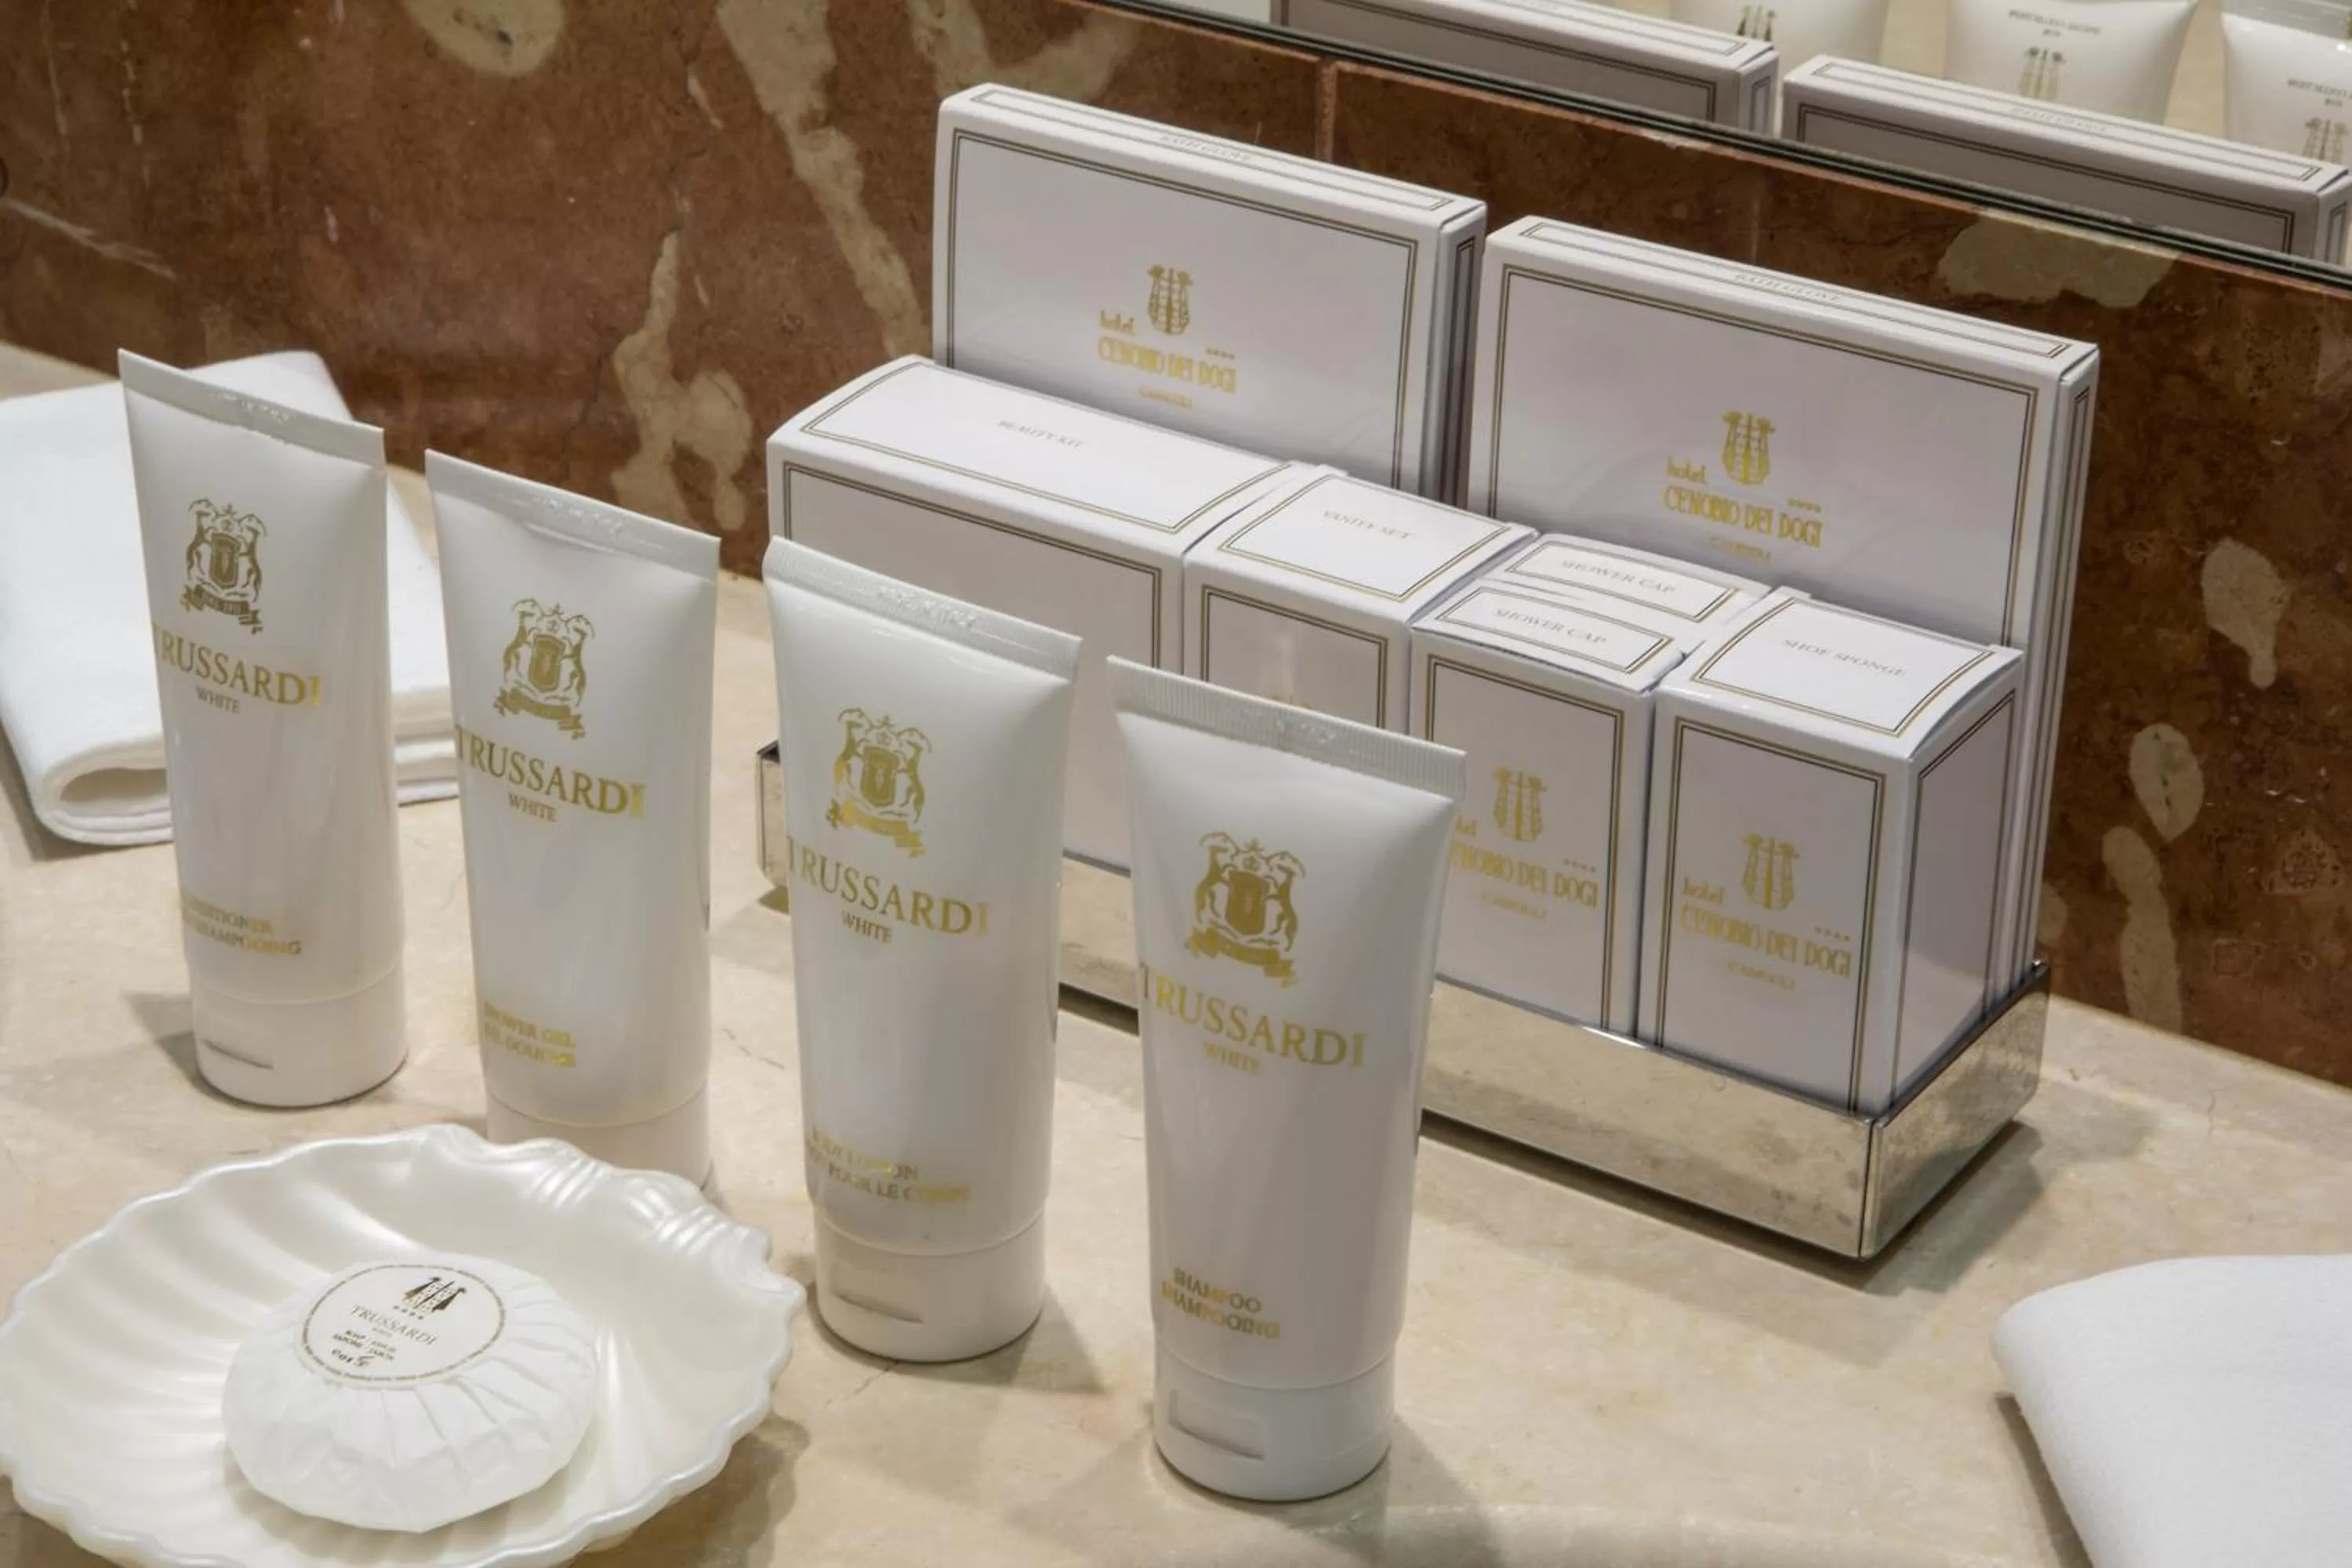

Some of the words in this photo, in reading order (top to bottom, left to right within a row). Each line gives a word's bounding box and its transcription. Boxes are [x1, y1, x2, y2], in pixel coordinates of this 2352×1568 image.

[1743, 503, 1773, 535] DEI
[1777, 511, 1824, 548] DOGI
[1560, 559, 1636, 584] SHOWER
[1639, 577, 1676, 595] CAP
[1493, 607, 1565, 633] SHOWER
[1566, 627, 1608, 645] CAP
[1781, 638, 1831, 656] SHOE
[1833, 652, 1907, 678] SPONGE
[194, 684, 241, 715] WHITE
[455, 723, 648, 819] TRUSSARDI
[507, 790, 558, 823] WHITE
[786, 833, 989, 936] TRUSSARDI
[1518, 861, 1547, 896] DEI
[1554, 871, 1599, 911] DOGI
[841, 907, 894, 945] WHITE
[1766, 927, 1798, 964] DEI
[1804, 939, 1853, 979] DOGI
[1139, 960, 1368, 1069] TRUSSARDI
[1203, 1040, 1263, 1076] WHITE
[350, 1302, 440, 1347] TRUSSARDI
